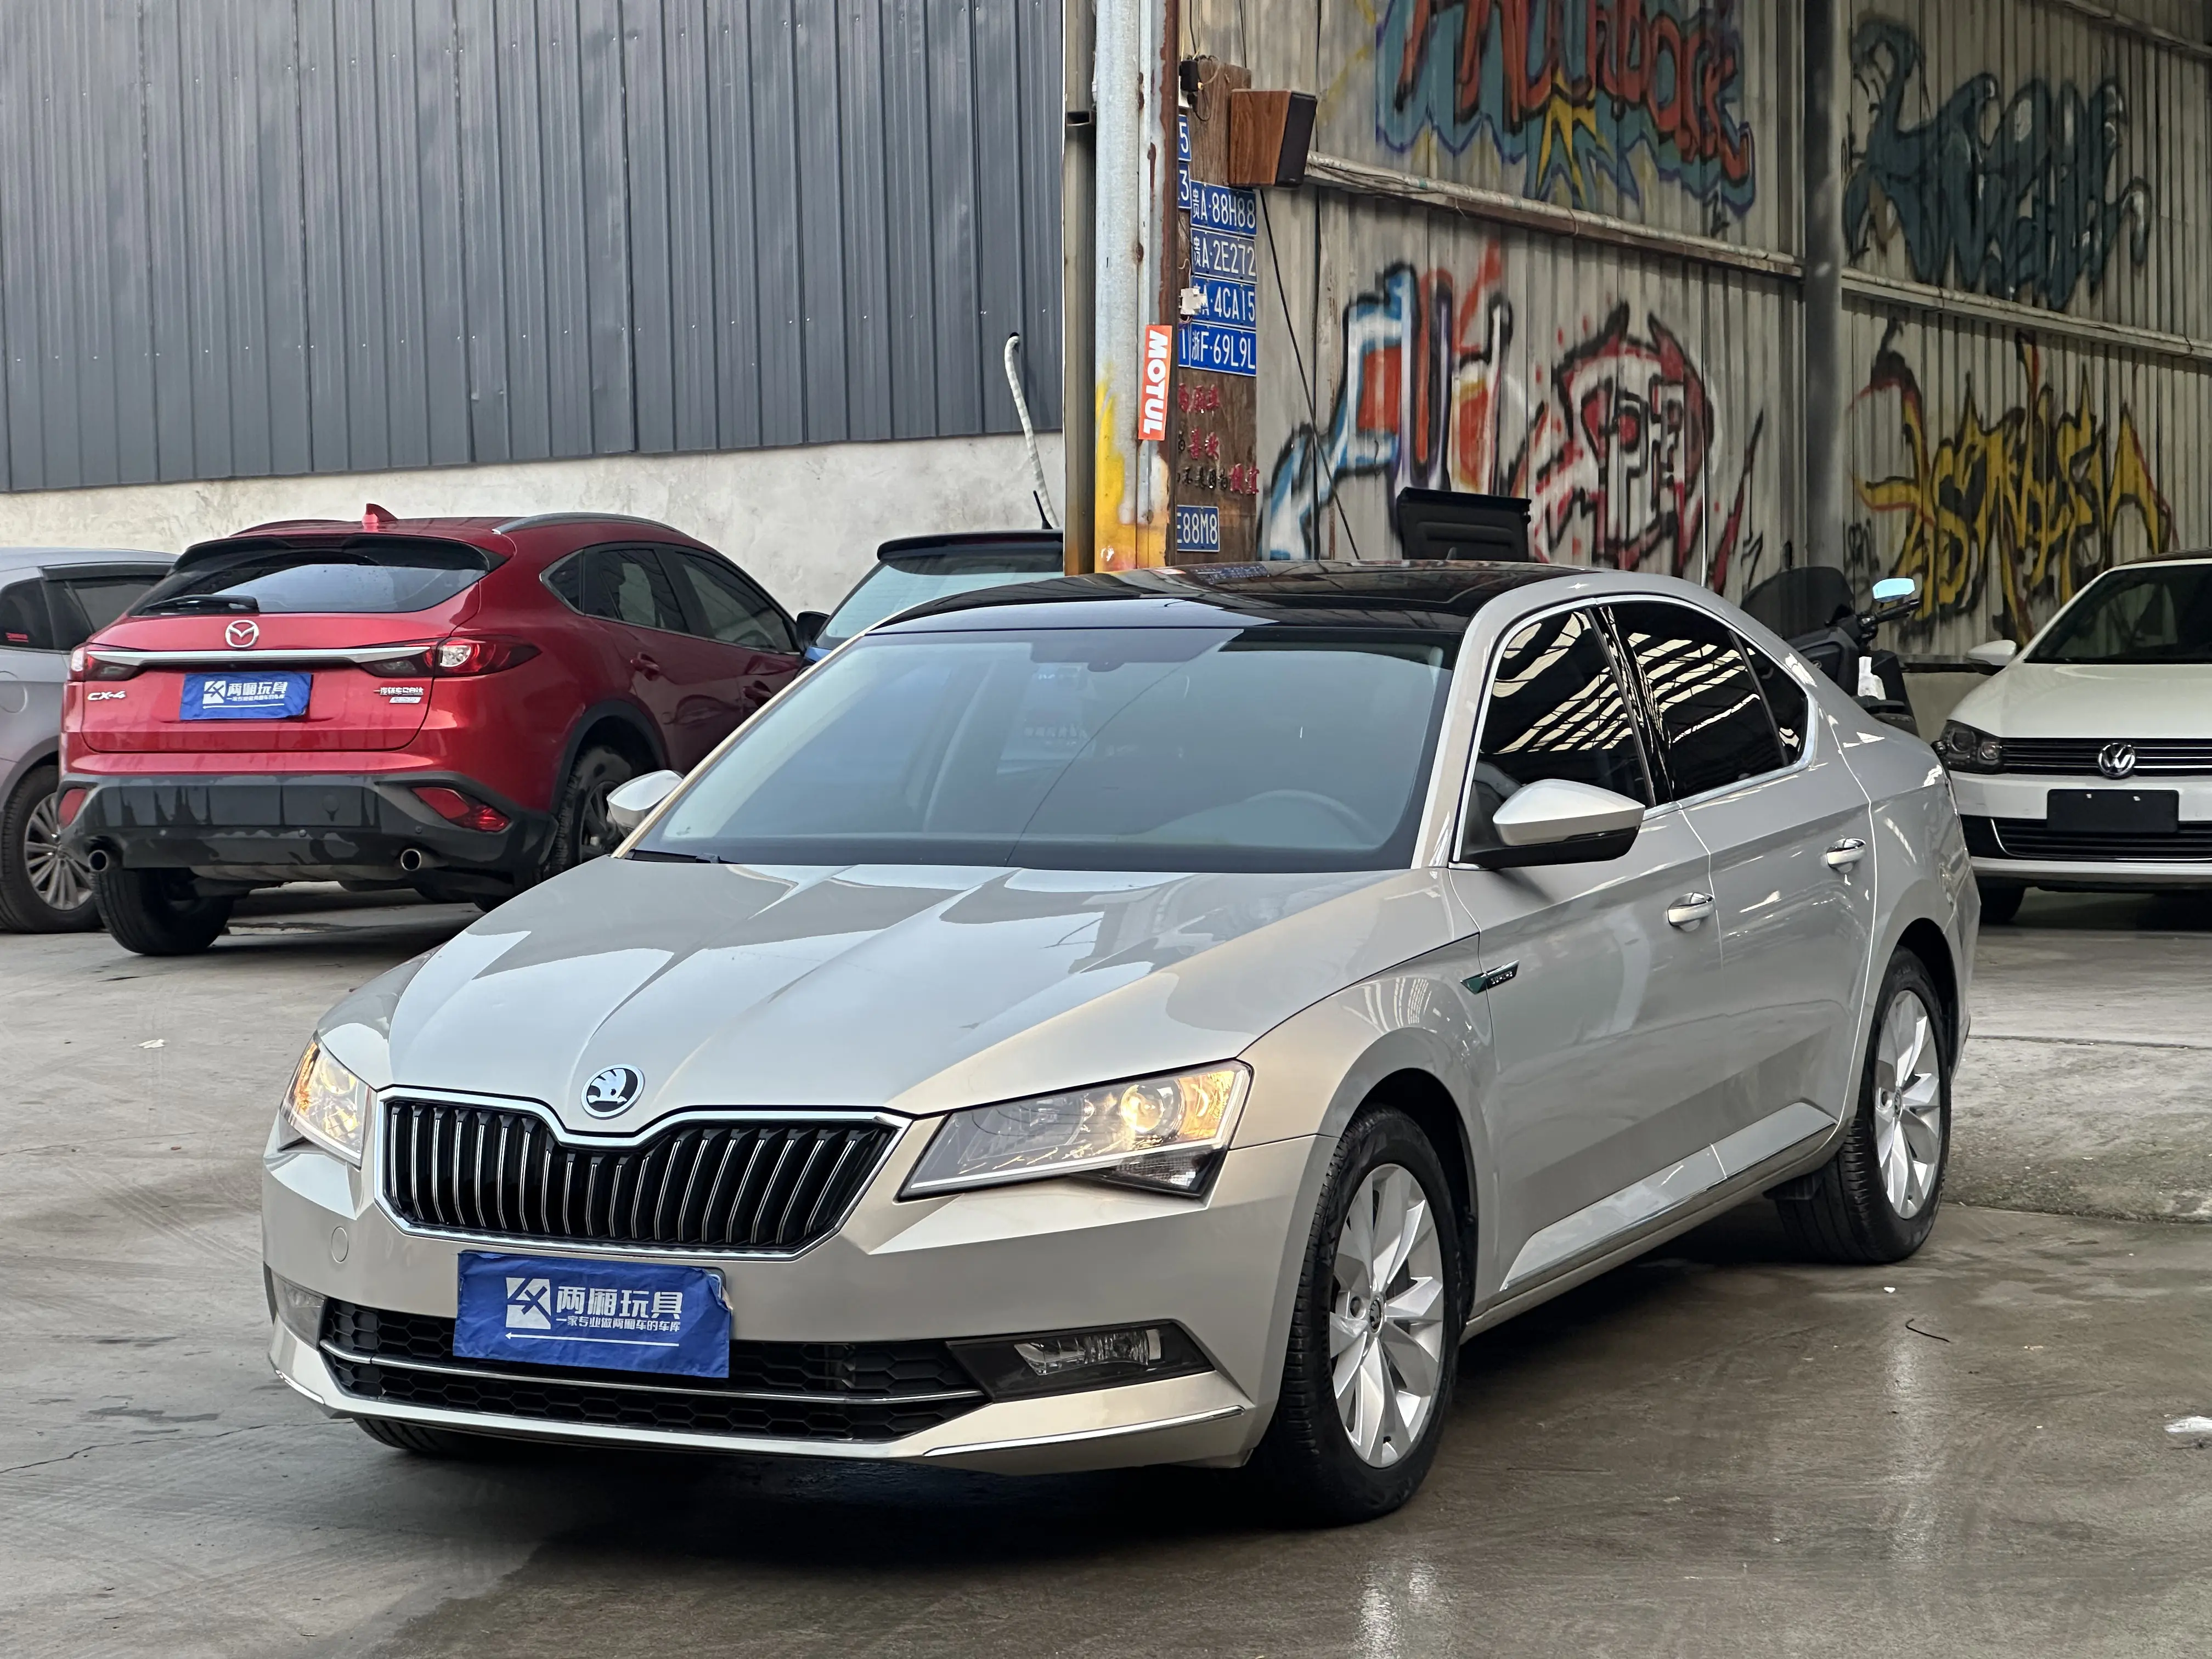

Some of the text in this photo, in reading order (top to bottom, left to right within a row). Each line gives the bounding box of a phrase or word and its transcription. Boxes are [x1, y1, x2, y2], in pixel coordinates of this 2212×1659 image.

[1179, 122, 1189, 153] 5
[1180, 170, 1189, 201] 3
[1193, 189, 1255, 228] 贵A·88H88
[1193, 236, 1256, 276] 贵A·2E272
[1193, 283, 1255, 321] A·4CA15
[1192, 330, 1256, 369] 浙F·69L9L
[1143, 330, 1168, 434] MOTUL
[87, 691, 126, 700] CX-4
[556, 1286, 684, 1319] 两厢玩具
[556, 1316, 681, 1332] 一家专业做两厢车的车库
